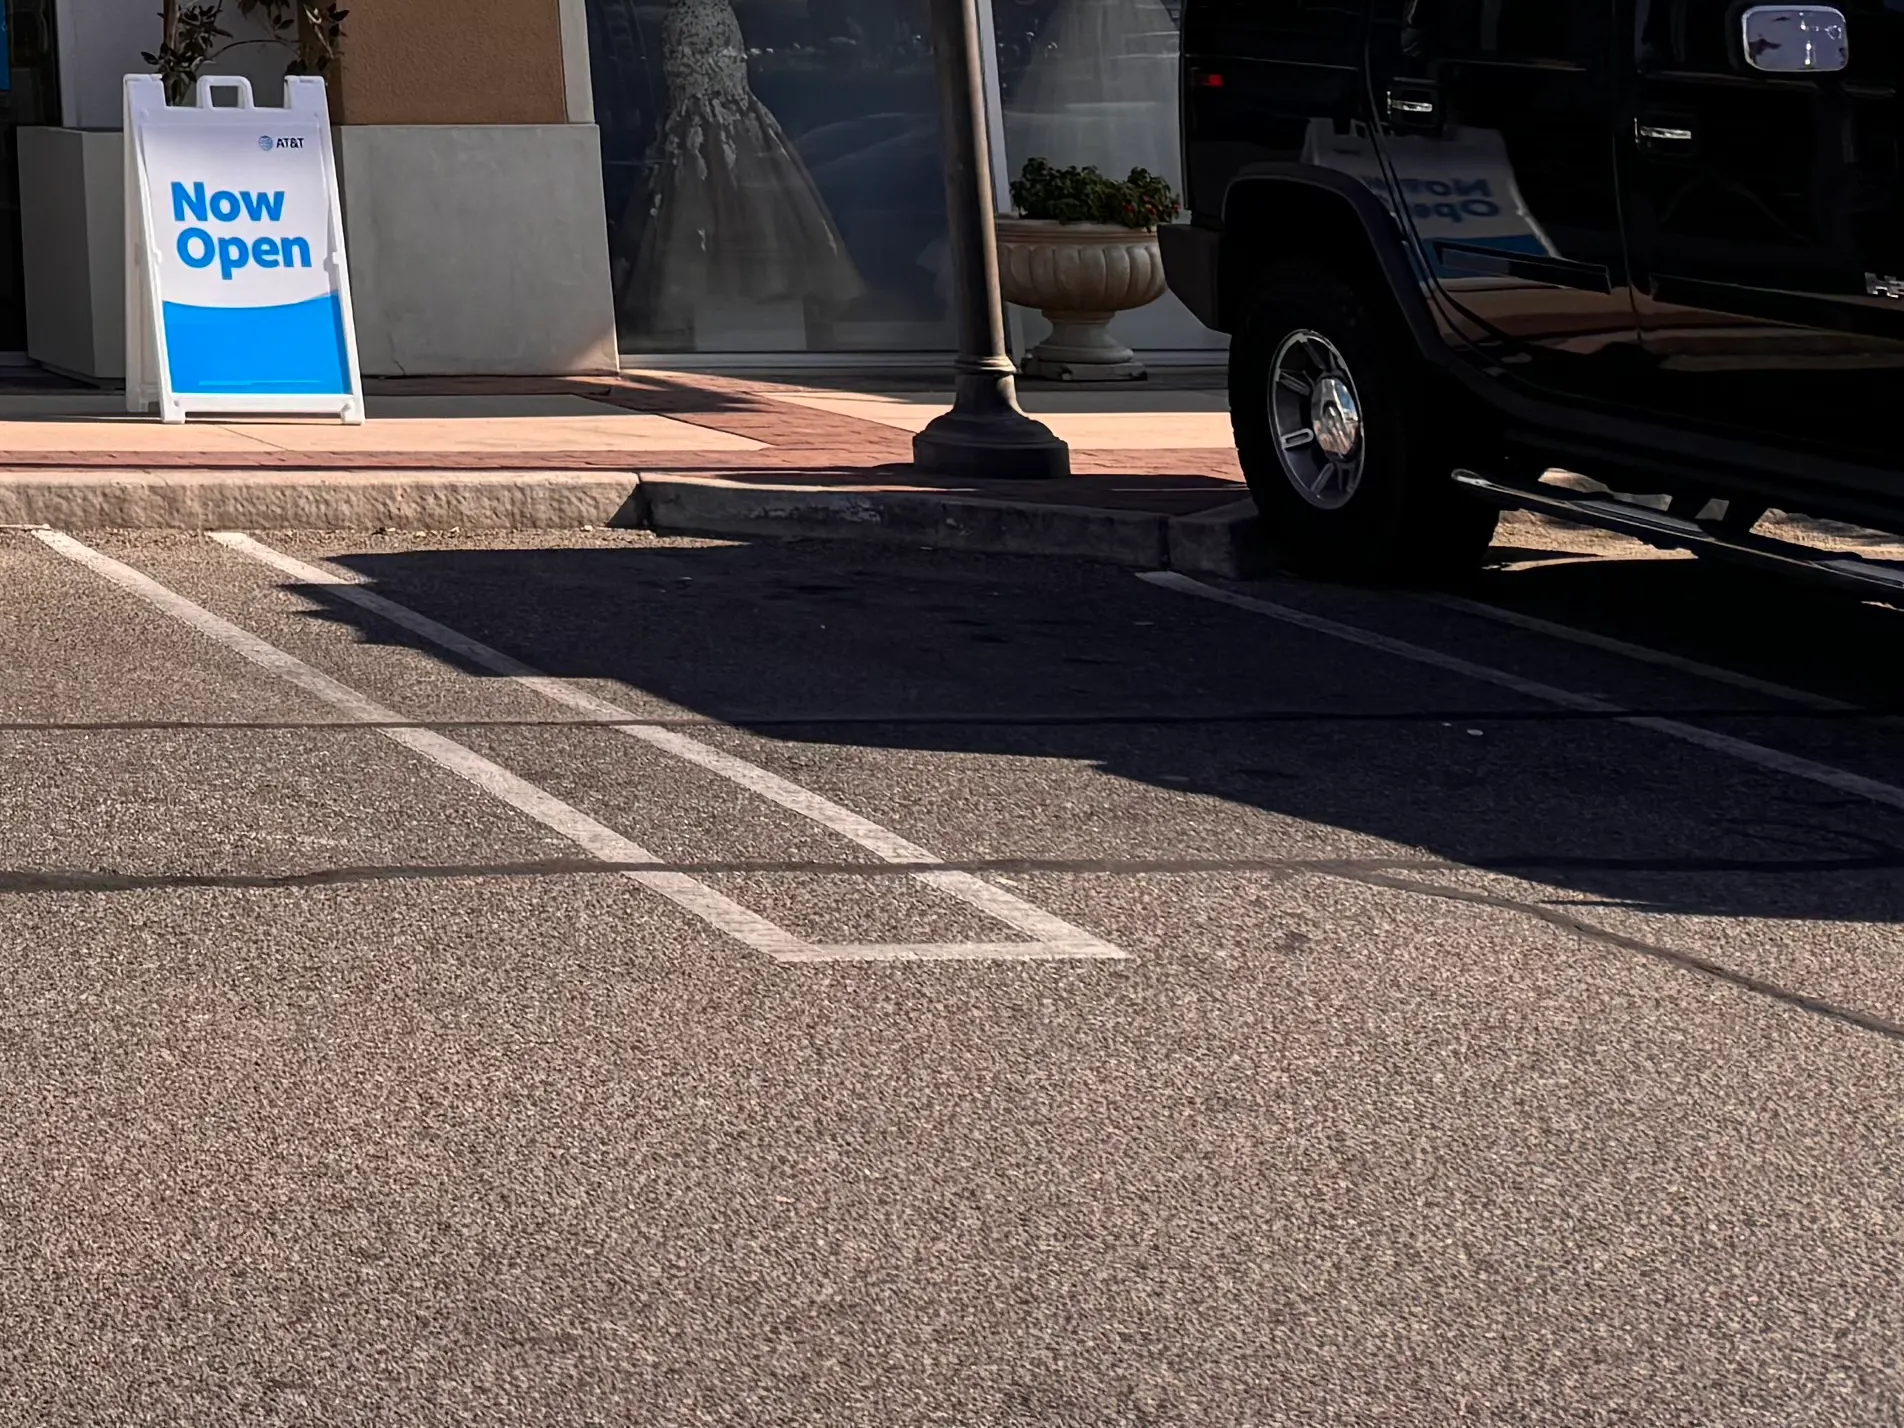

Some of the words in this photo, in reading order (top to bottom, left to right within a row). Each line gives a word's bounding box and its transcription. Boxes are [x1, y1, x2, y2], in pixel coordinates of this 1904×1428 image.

[275, 137, 305, 149] AT&T
[170, 181, 285, 222] Now
[176, 227, 313, 280] Open
